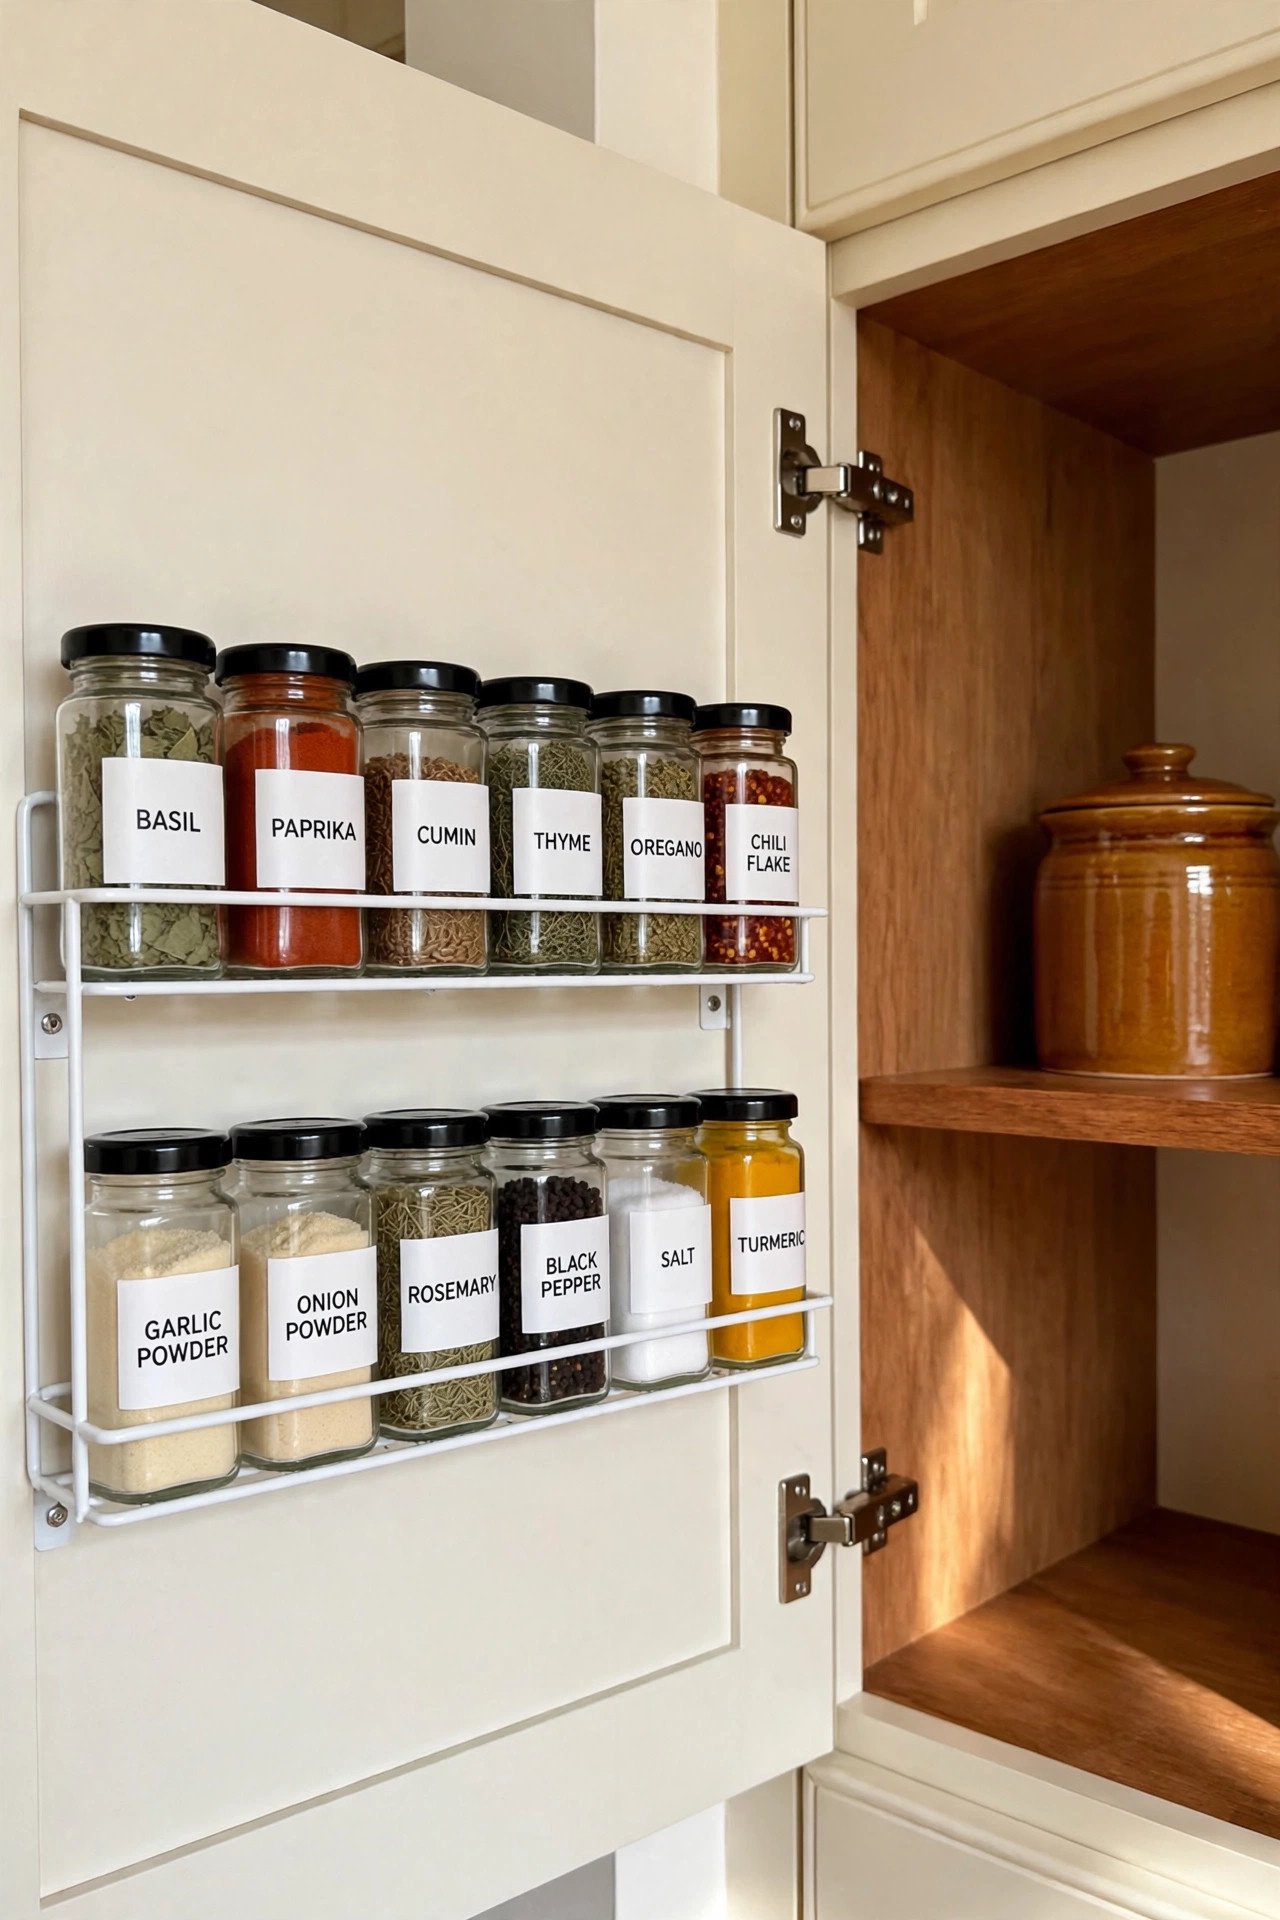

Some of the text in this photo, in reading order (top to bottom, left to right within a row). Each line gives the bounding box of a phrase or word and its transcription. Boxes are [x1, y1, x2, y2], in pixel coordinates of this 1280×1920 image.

[136, 808, 201, 833] BASIL
[271, 817, 358, 841] PAPRIKA
[416, 825, 476, 846] CUMIN
[533, 832, 591, 852] THYME
[750, 833, 787, 851] CHILI
[630, 838, 704, 859] OREGANO
[746, 854, 791, 873] FLAKE
[737, 1229, 805, 1253] TURMERIC
[545, 1250, 599, 1275] BLACK
[660, 1246, 695, 1268] SALT
[407, 1274, 497, 1304] ROSEMARY
[541, 1273, 601, 1299] PEPPER
[296, 1287, 358, 1315] ONION
[144, 1310, 222, 1341] GARLIC
[285, 1311, 367, 1341] POWDER
[137, 1335, 228, 1368] POWDER
